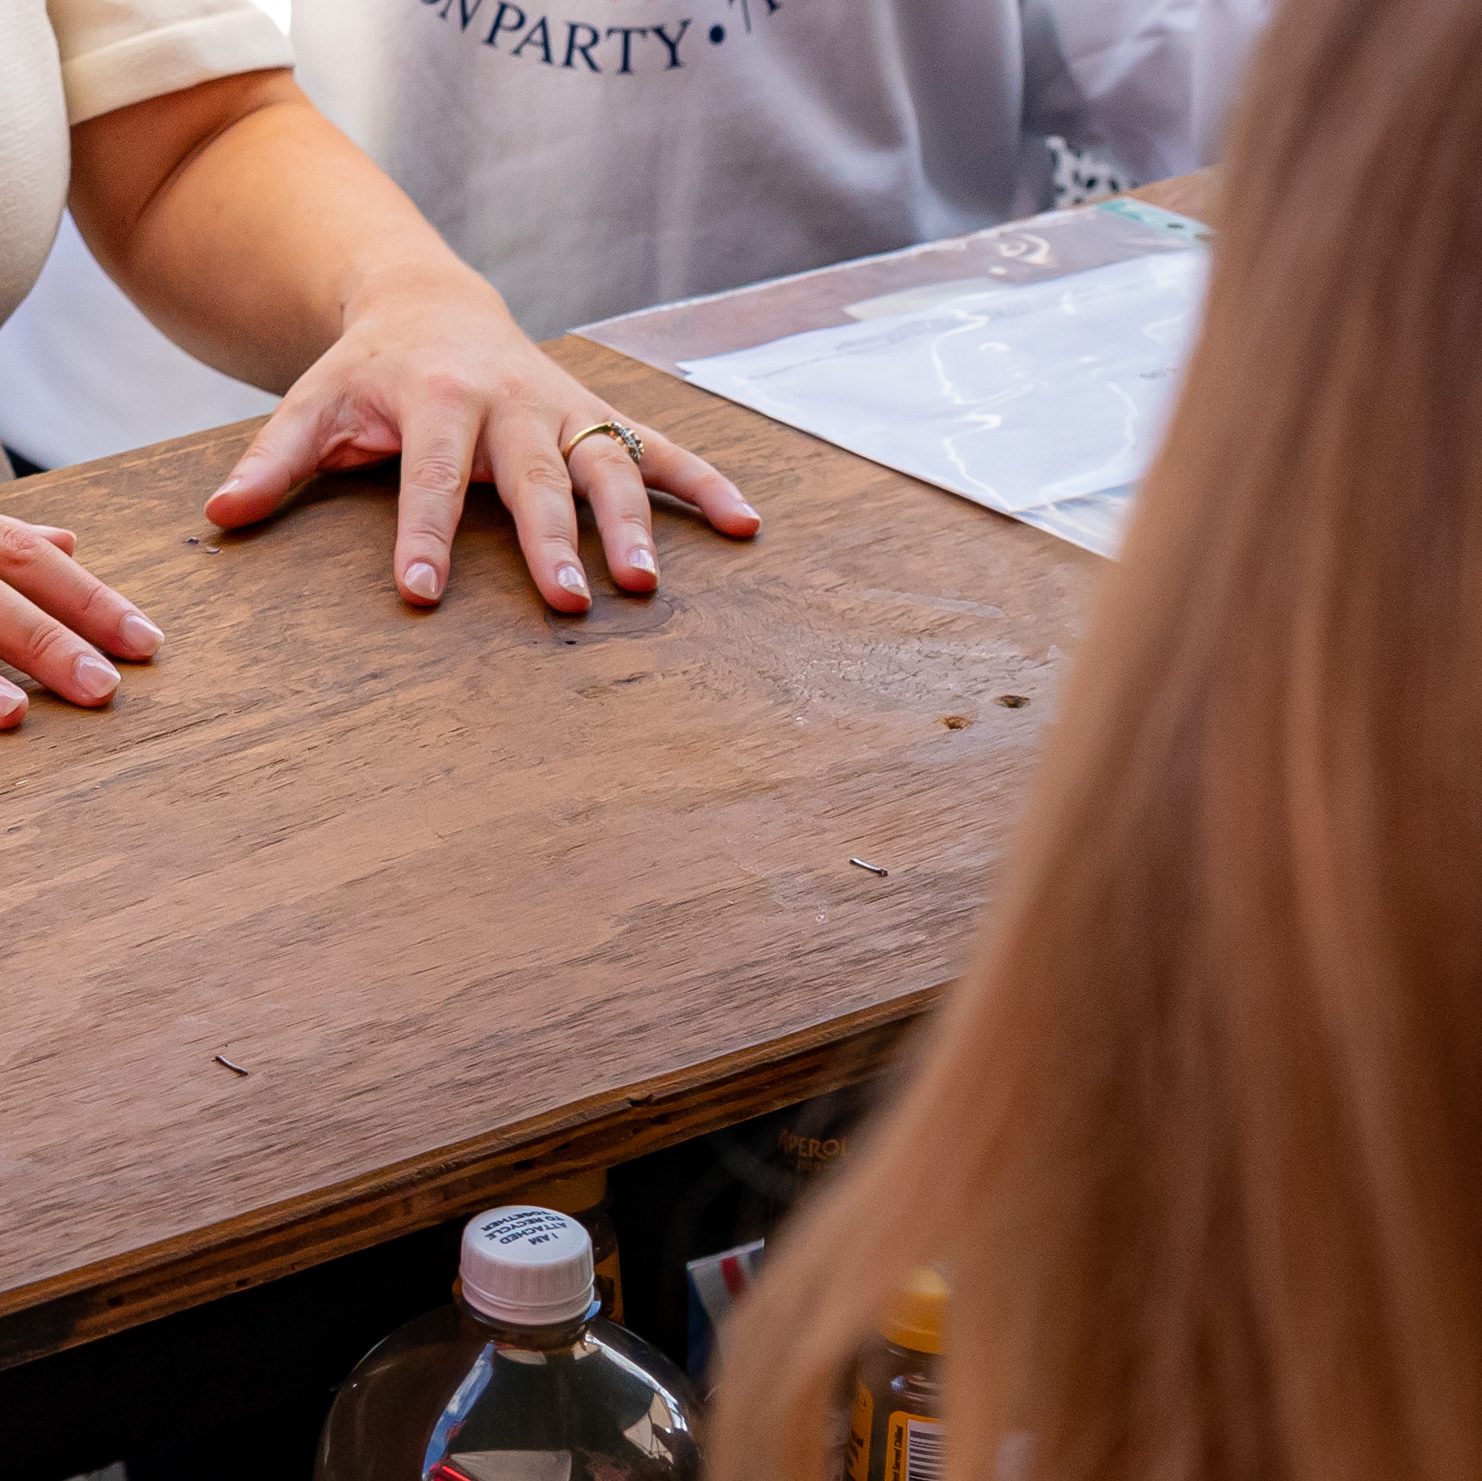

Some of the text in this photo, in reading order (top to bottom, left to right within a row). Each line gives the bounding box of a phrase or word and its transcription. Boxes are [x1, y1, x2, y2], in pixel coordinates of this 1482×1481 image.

[482, 0, 693, 75] PARTY
[480, 1210, 551, 1232] TOGETHER
[484, 1216, 545, 1241] RECYCLE
[499, 1222, 568, 1245] ATTACHED
[528, 1233, 550, 1246] AM
